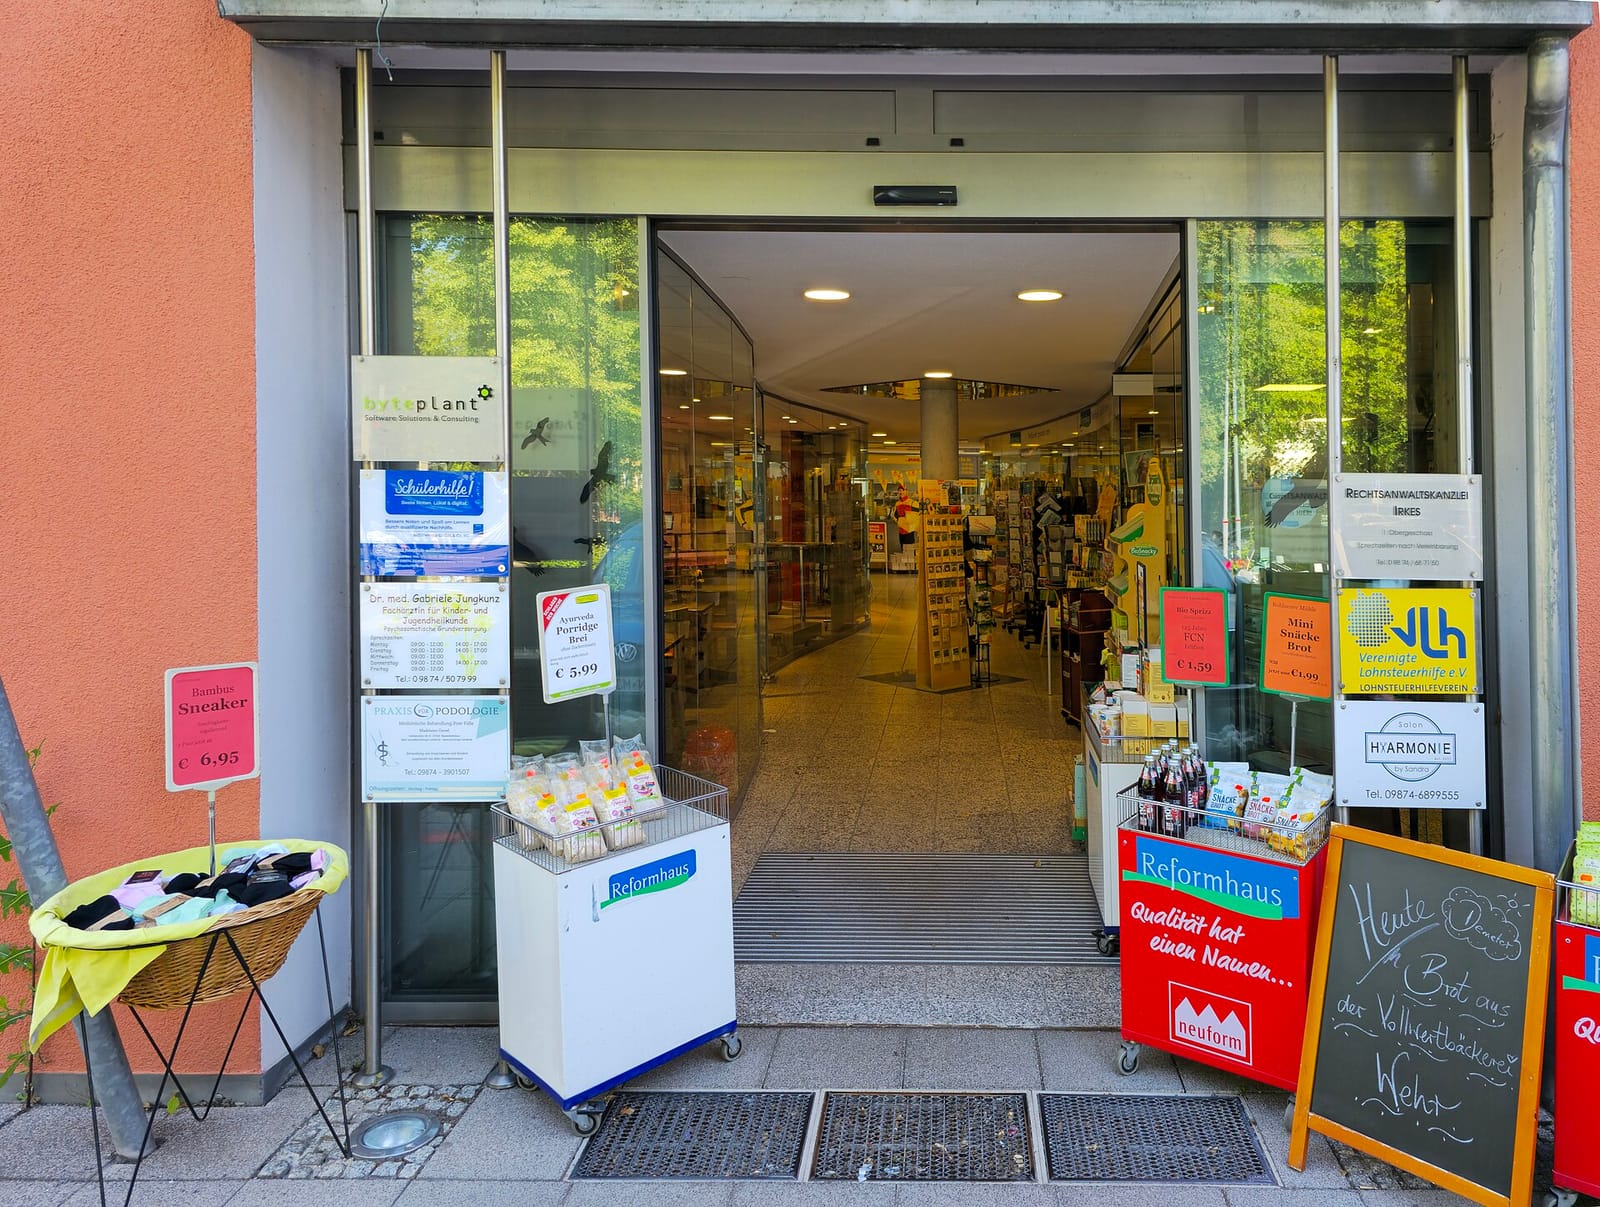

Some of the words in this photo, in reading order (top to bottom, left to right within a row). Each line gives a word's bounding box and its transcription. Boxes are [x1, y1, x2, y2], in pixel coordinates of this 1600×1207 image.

[363, 396, 478, 412] byteplant
[394, 478, 474, 499] Schülerhilfe!
[1345, 488, 1469, 500] RECHTSANWALTSKANZLEI
[1393, 505, 1421, 516] IRKES
[369, 594, 384, 603] Dr.
[387, 594, 409, 603] med.
[412, 594, 453, 603] Gabriele
[455, 594, 500, 605] Jungkunz
[382, 606, 425, 615] Fachärztin
[427, 606, 441, 615] für
[442, 606, 471, 615] Kinder-
[473, 607, 488, 615] und
[403, 617, 468, 627] Jugendheilkunde
[560, 612, 594, 624] Ayurveda
[1288, 618, 1314, 629] Mini
[556, 622, 599, 635] Porridge
[569, 634, 588, 645] Brei
[1184, 633, 1205, 642] FCN
[1280, 629, 1320, 642] Snäcke
[1287, 642, 1312, 653] Brot
[1177, 659, 1186, 669] €
[1359, 652, 1418, 666] Vereinigte
[555, 668, 564, 679] €
[1359, 667, 1446, 680] Lohnsteuerhilfe
[192, 685, 235, 697] Bambus
[1360, 684, 1468, 692] LOHNSTEUERHILFEVEREIN
[178, 698, 248, 715] Sneaker
[374, 707, 412, 716] PRAXIS
[435, 707, 500, 716] PODOLOGIE
[1398, 721, 1424, 729] Salon
[178, 758, 189, 770] €
[200, 751, 240, 768] 6,95
[1365, 790, 1382, 799] Tel.
[612, 863, 689, 898] Reformhaus
[1141, 852, 1283, 906] Reformhaus
[1130, 901, 1208, 935] Qualität
[1209, 916, 1246, 944] hat
[1349, 883, 1436, 961] Heute
[1149, 934, 1196, 961] einen
[1403, 953, 1472, 1004] Brot
[1475, 996, 1512, 1018] aus
[1337, 994, 1367, 1018] der
[1178, 1019, 1242, 1052] neuform
[1376, 1051, 1463, 1116] Wehr
